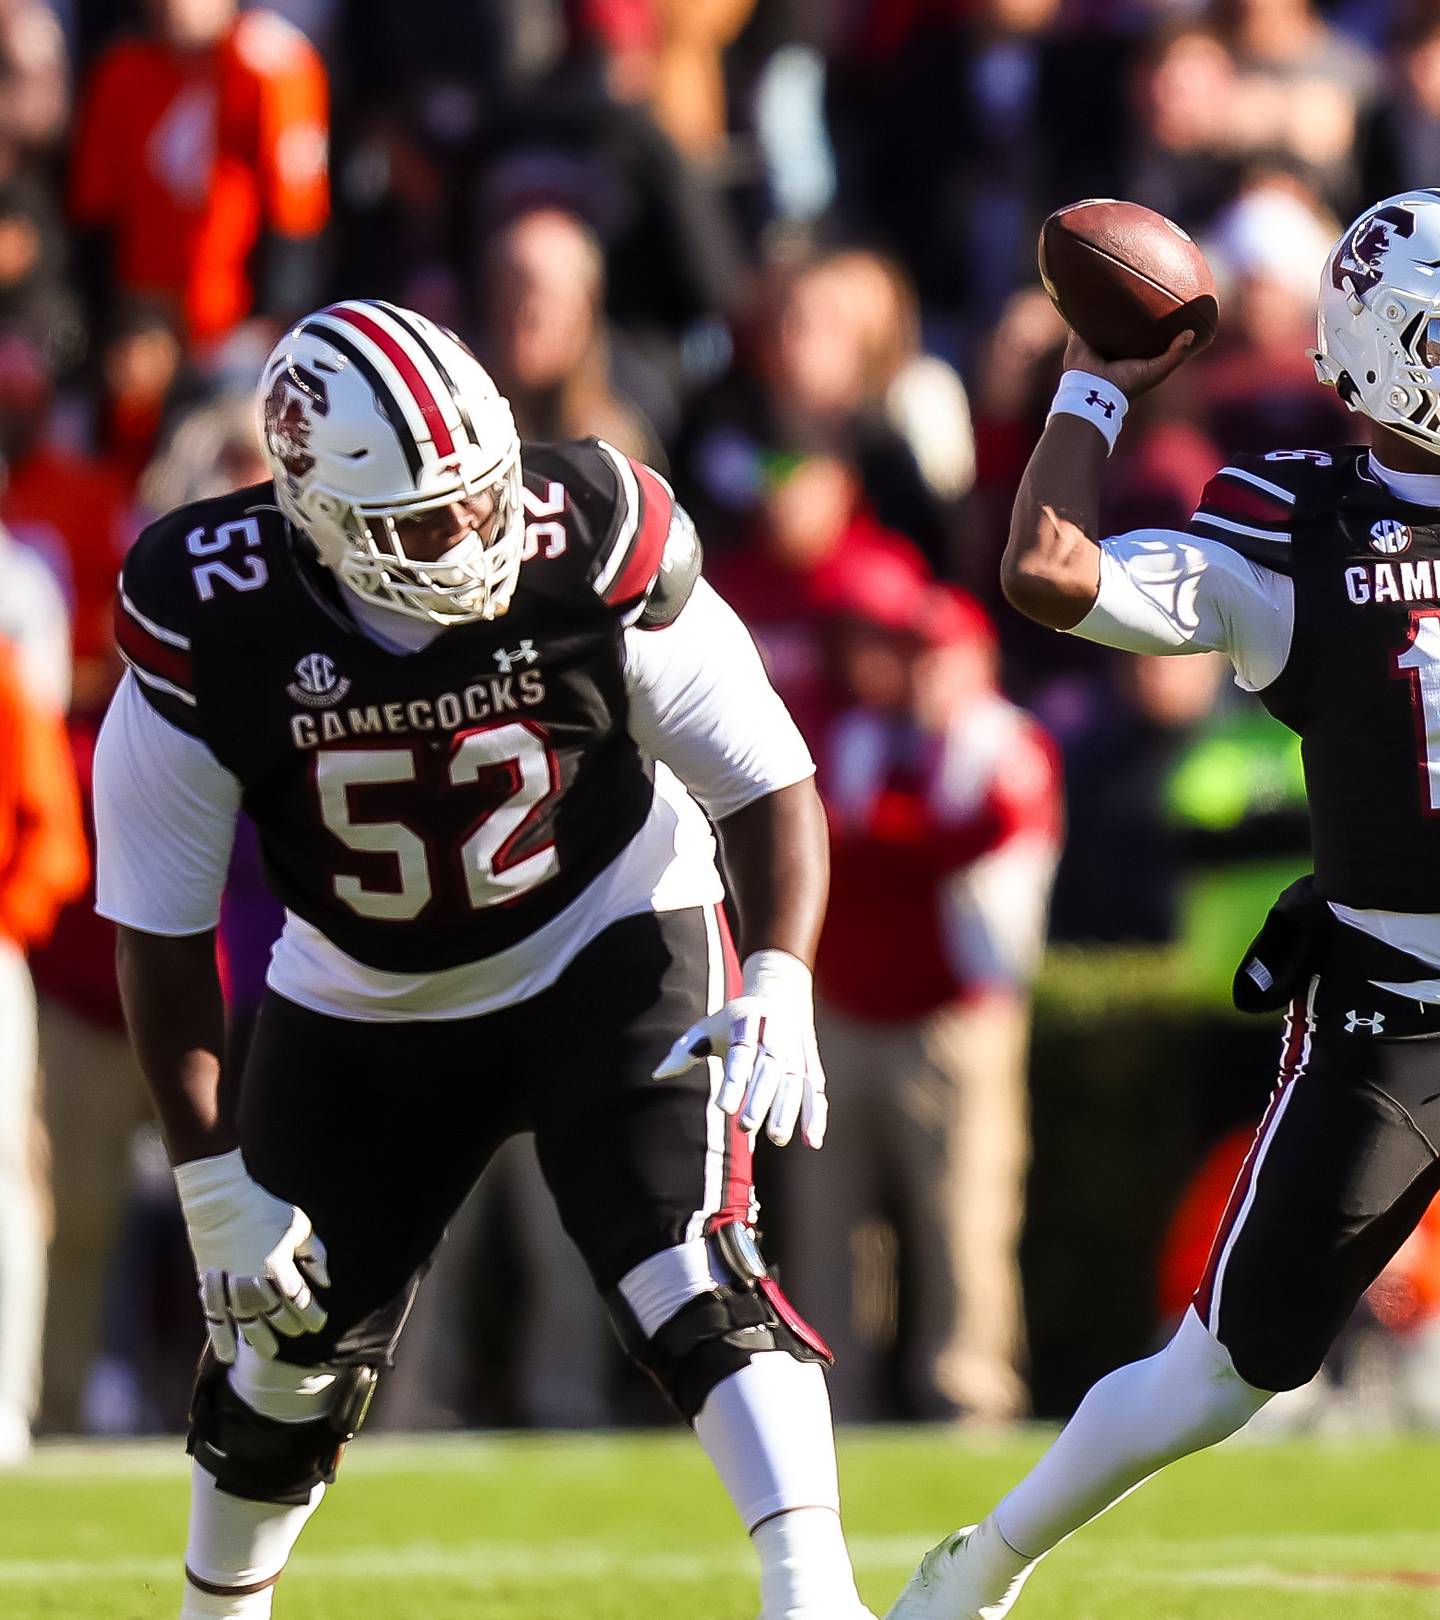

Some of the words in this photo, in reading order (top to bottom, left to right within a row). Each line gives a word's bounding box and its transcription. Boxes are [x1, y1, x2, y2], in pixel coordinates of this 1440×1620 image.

[185, 516, 269, 601] 52
[1369, 518, 1410, 554] SEC
[289, 670, 546, 749] GAMECOCKS
[294, 652, 338, 694] SEC
[314, 720, 561, 923] 52
